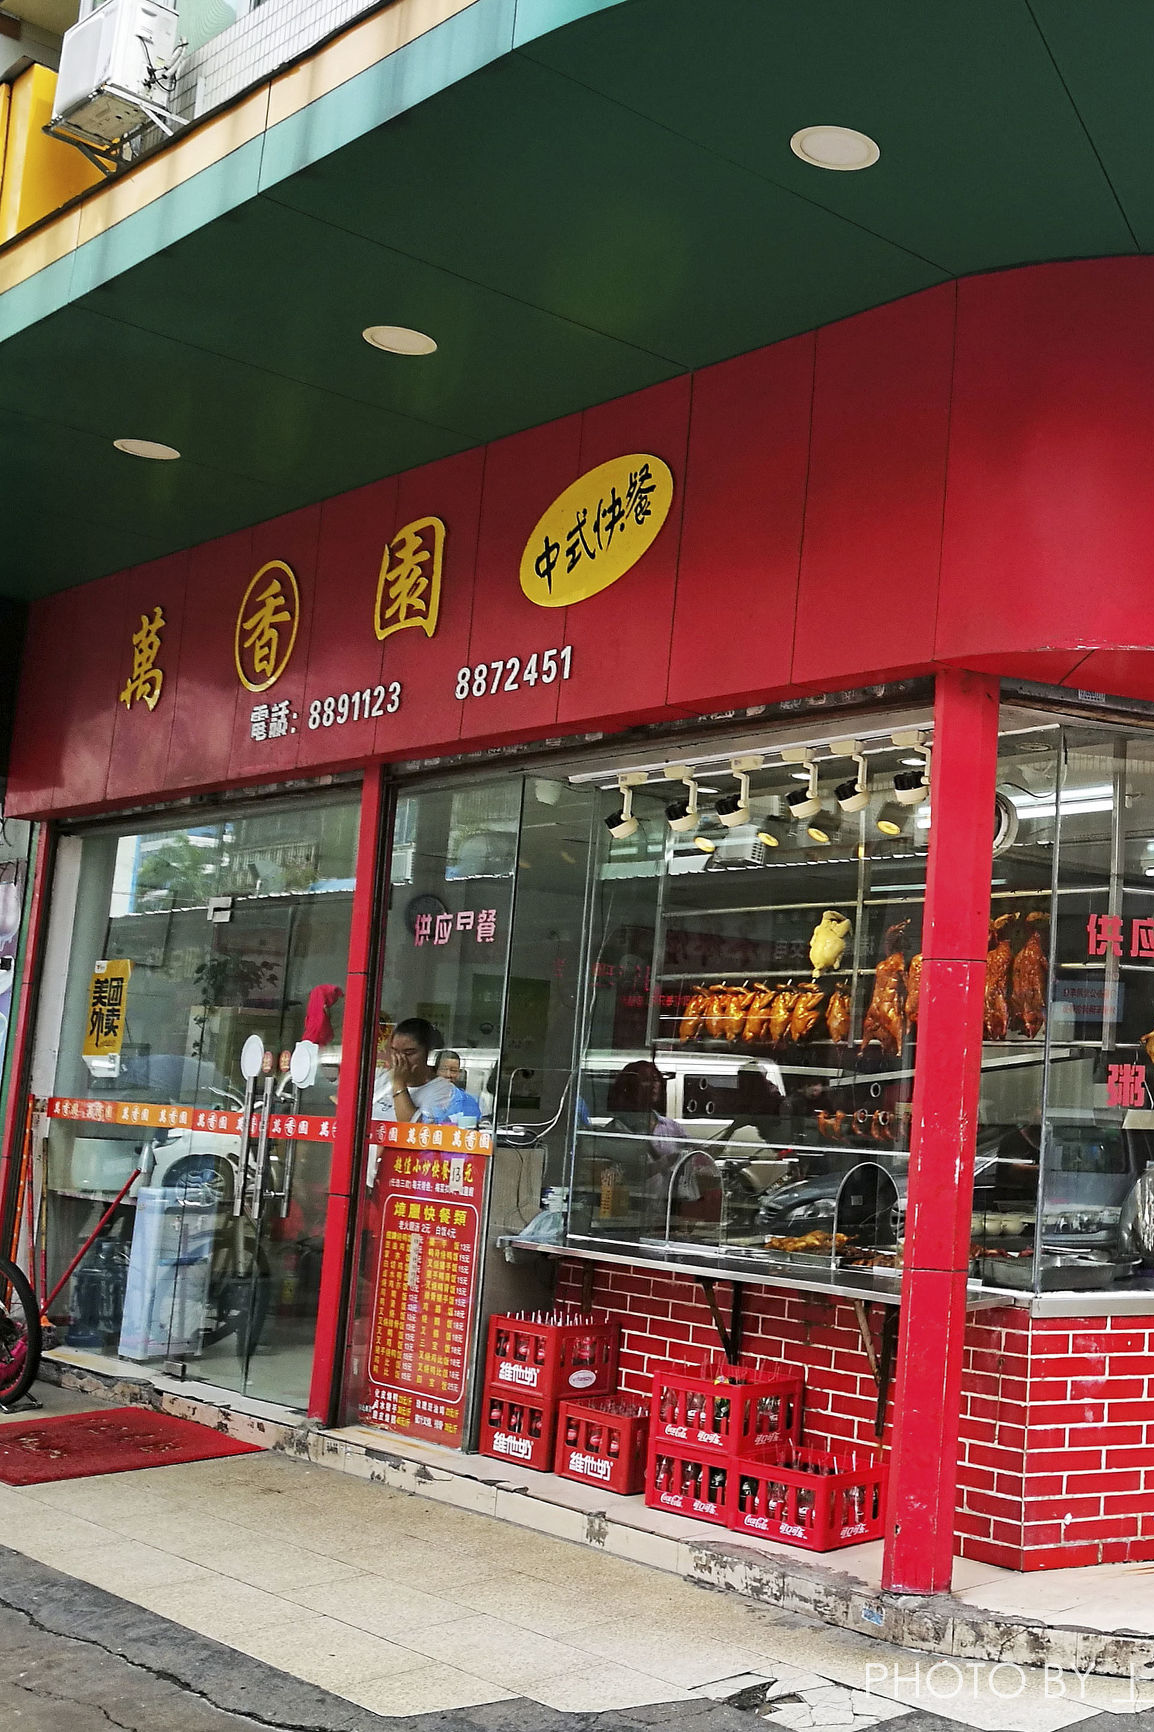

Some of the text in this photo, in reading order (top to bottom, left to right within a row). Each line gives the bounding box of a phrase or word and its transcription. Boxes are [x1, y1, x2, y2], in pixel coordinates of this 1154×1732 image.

[535, 464, 656, 594] 中式快餐
[120, 515, 446, 711] 萬香園
[308, 682, 401, 728] 8891123
[455, 646, 572, 700] 8872451
[90, 1007, 121, 1048] 外卖
[92, 977, 124, 1007] 美团
